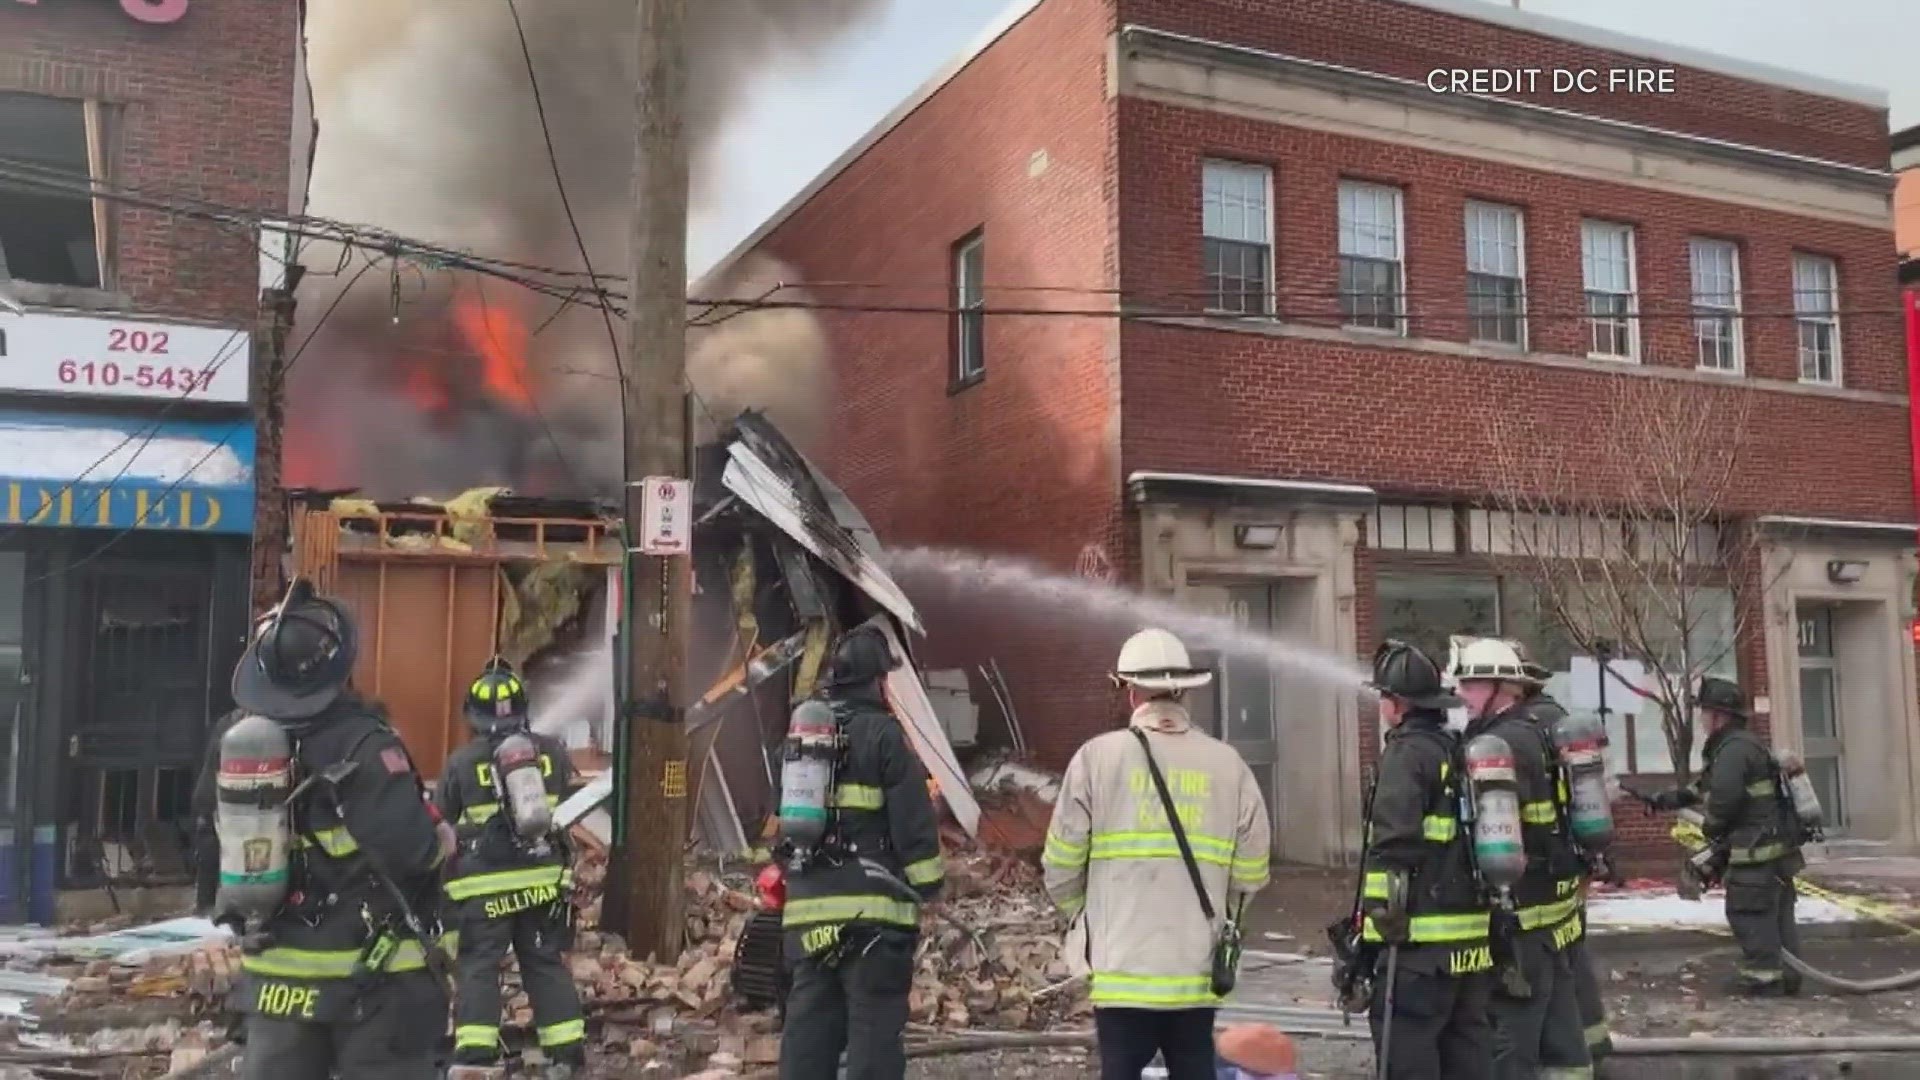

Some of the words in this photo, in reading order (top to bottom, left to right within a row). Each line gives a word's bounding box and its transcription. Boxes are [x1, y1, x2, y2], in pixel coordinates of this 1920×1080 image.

[108, 328, 169, 354] 202
[58, 358, 216, 392] 610-5437
[485, 884, 558, 918] SULLIVAN
[257, 983, 320, 1017] HOPE
